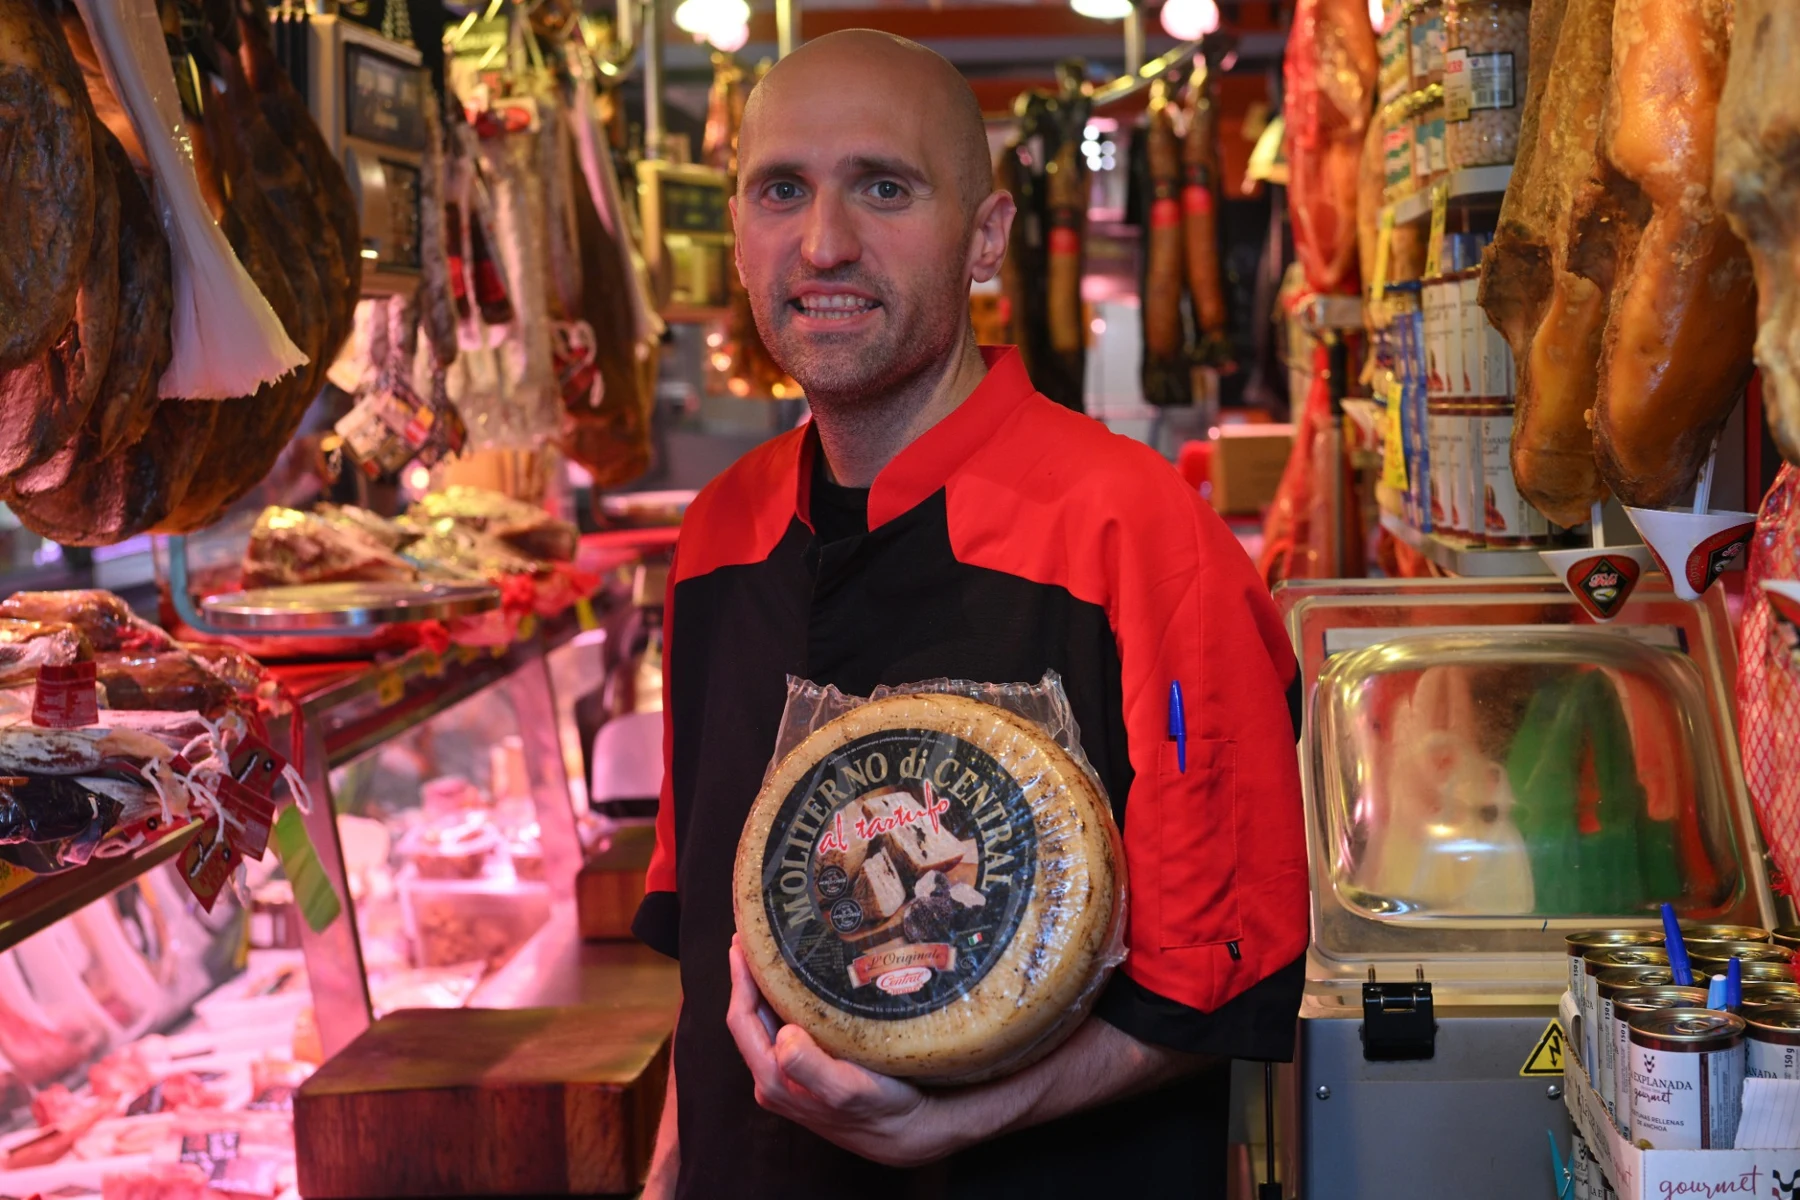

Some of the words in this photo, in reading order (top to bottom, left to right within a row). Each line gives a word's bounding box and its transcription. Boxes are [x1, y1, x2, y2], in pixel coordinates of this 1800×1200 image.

[818, 812, 848, 854] al
[855, 779, 950, 835] tartufo
[780, 752, 888, 928] MOLITERNO
[900, 747, 928, 780] di
[934, 758, 1015, 892] CENTRAL
[1784, 1054, 1793, 1068] 150
[1633, 1071, 1693, 1090] EXPLANADA
[1643, 1122, 1668, 1132] ANCHOA
[1651, 1116, 1685, 1127] RELLENAS
